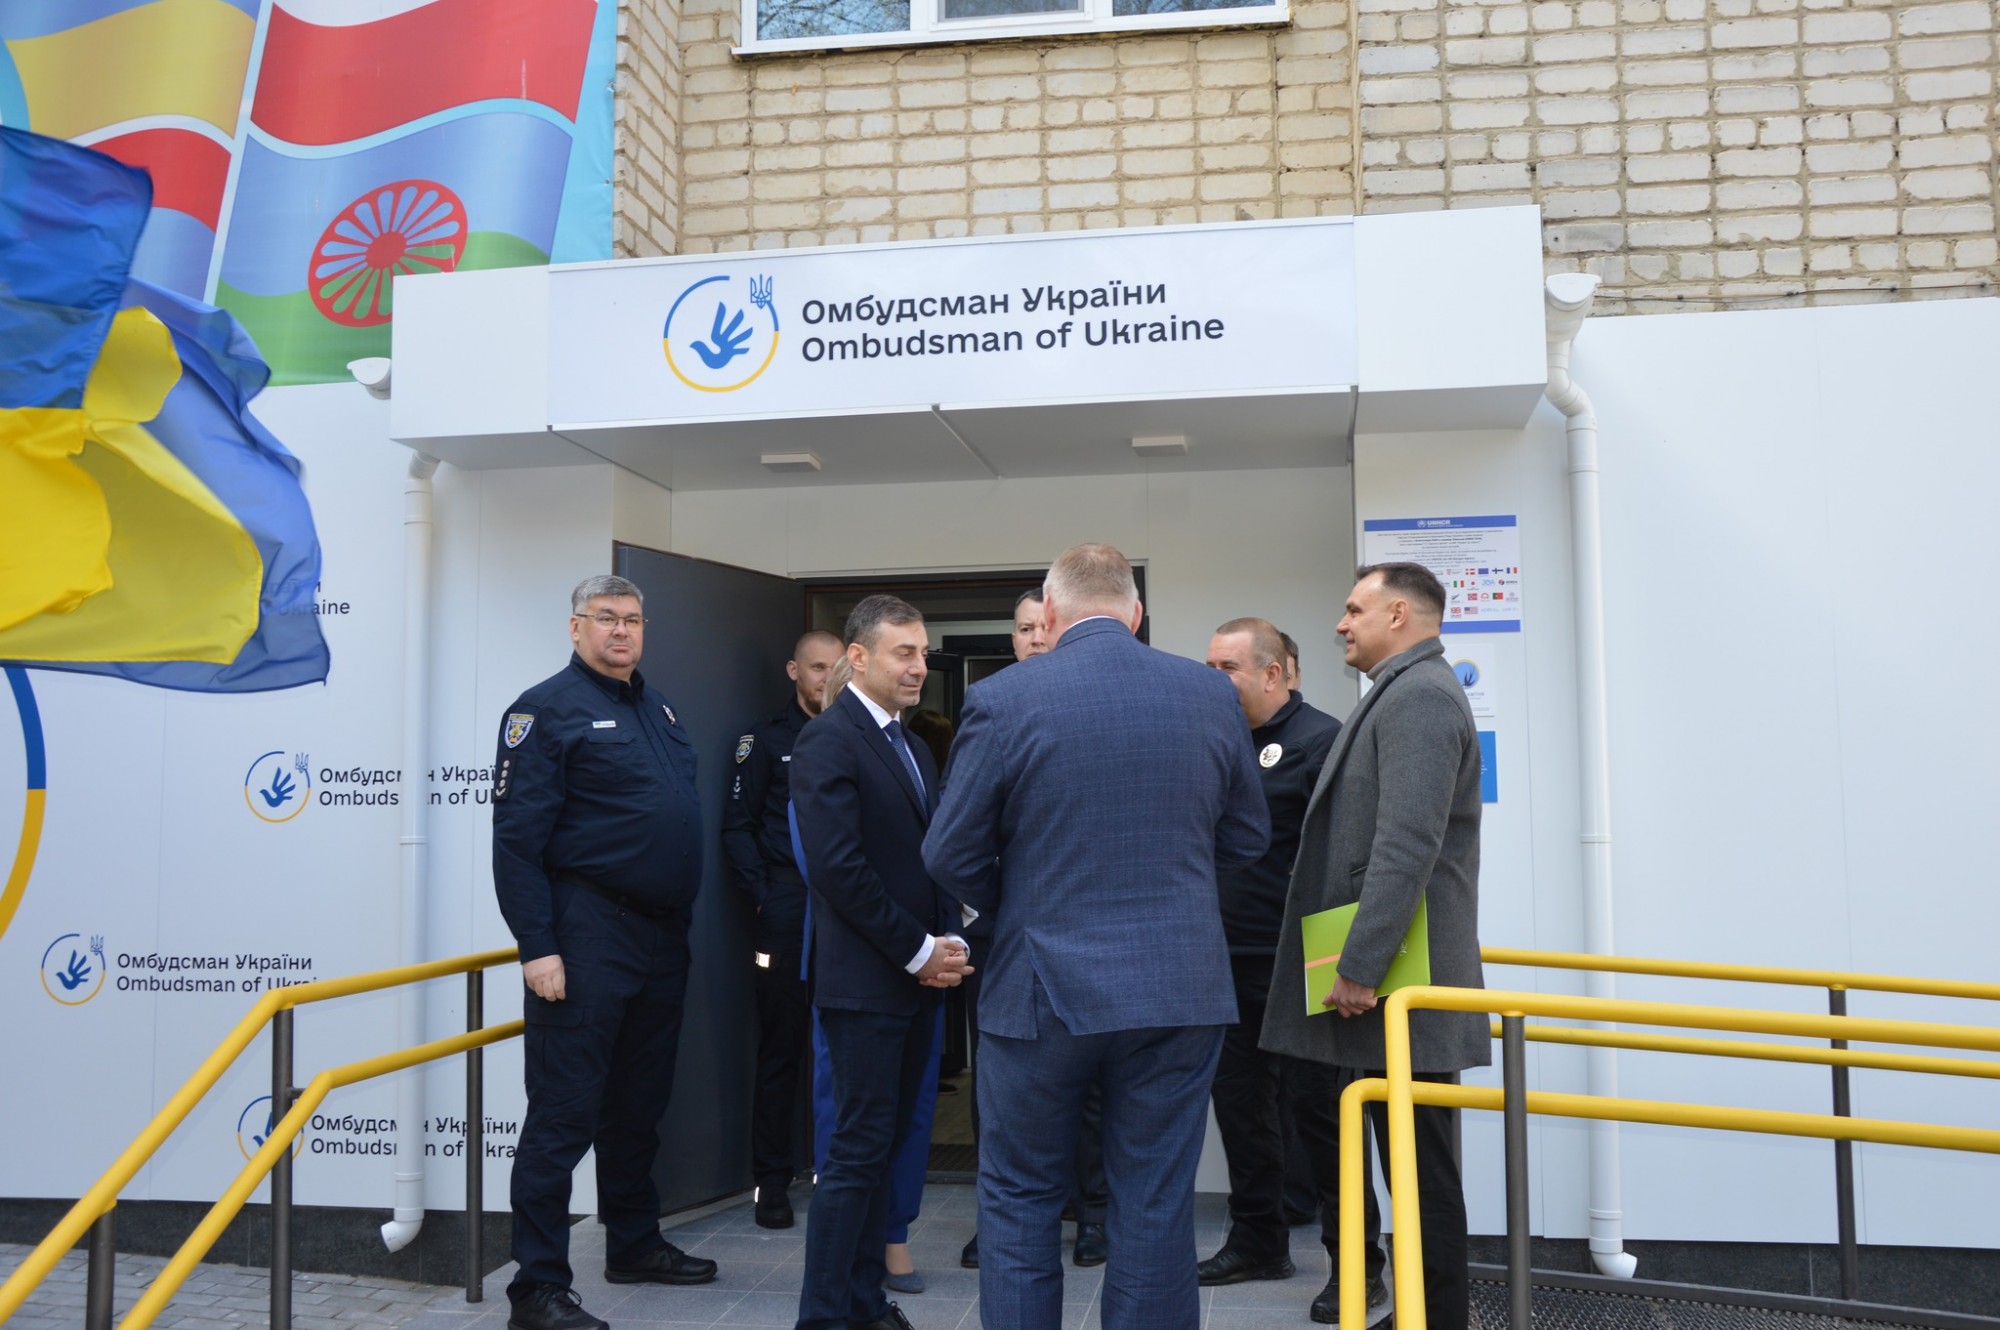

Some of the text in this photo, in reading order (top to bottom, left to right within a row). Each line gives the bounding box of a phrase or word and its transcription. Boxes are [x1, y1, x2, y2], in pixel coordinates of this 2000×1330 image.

[802, 279, 1167, 326] Омбудсман України
[802, 314, 1225, 362] Ombudsman of Ukraine
[319, 765, 495, 787] Омбудсн Украї
[319, 789, 442, 806] Ombudsn
[448, 788, 470, 805] of
[116, 953, 312, 974] Омбудсман України
[116, 975, 235, 993] Ombudsman
[241, 976, 262, 993] of
[435, 1116, 517, 1137] Укрїни
[311, 1138, 436, 1157] Ombudsn
[443, 1140, 464, 1157] of
